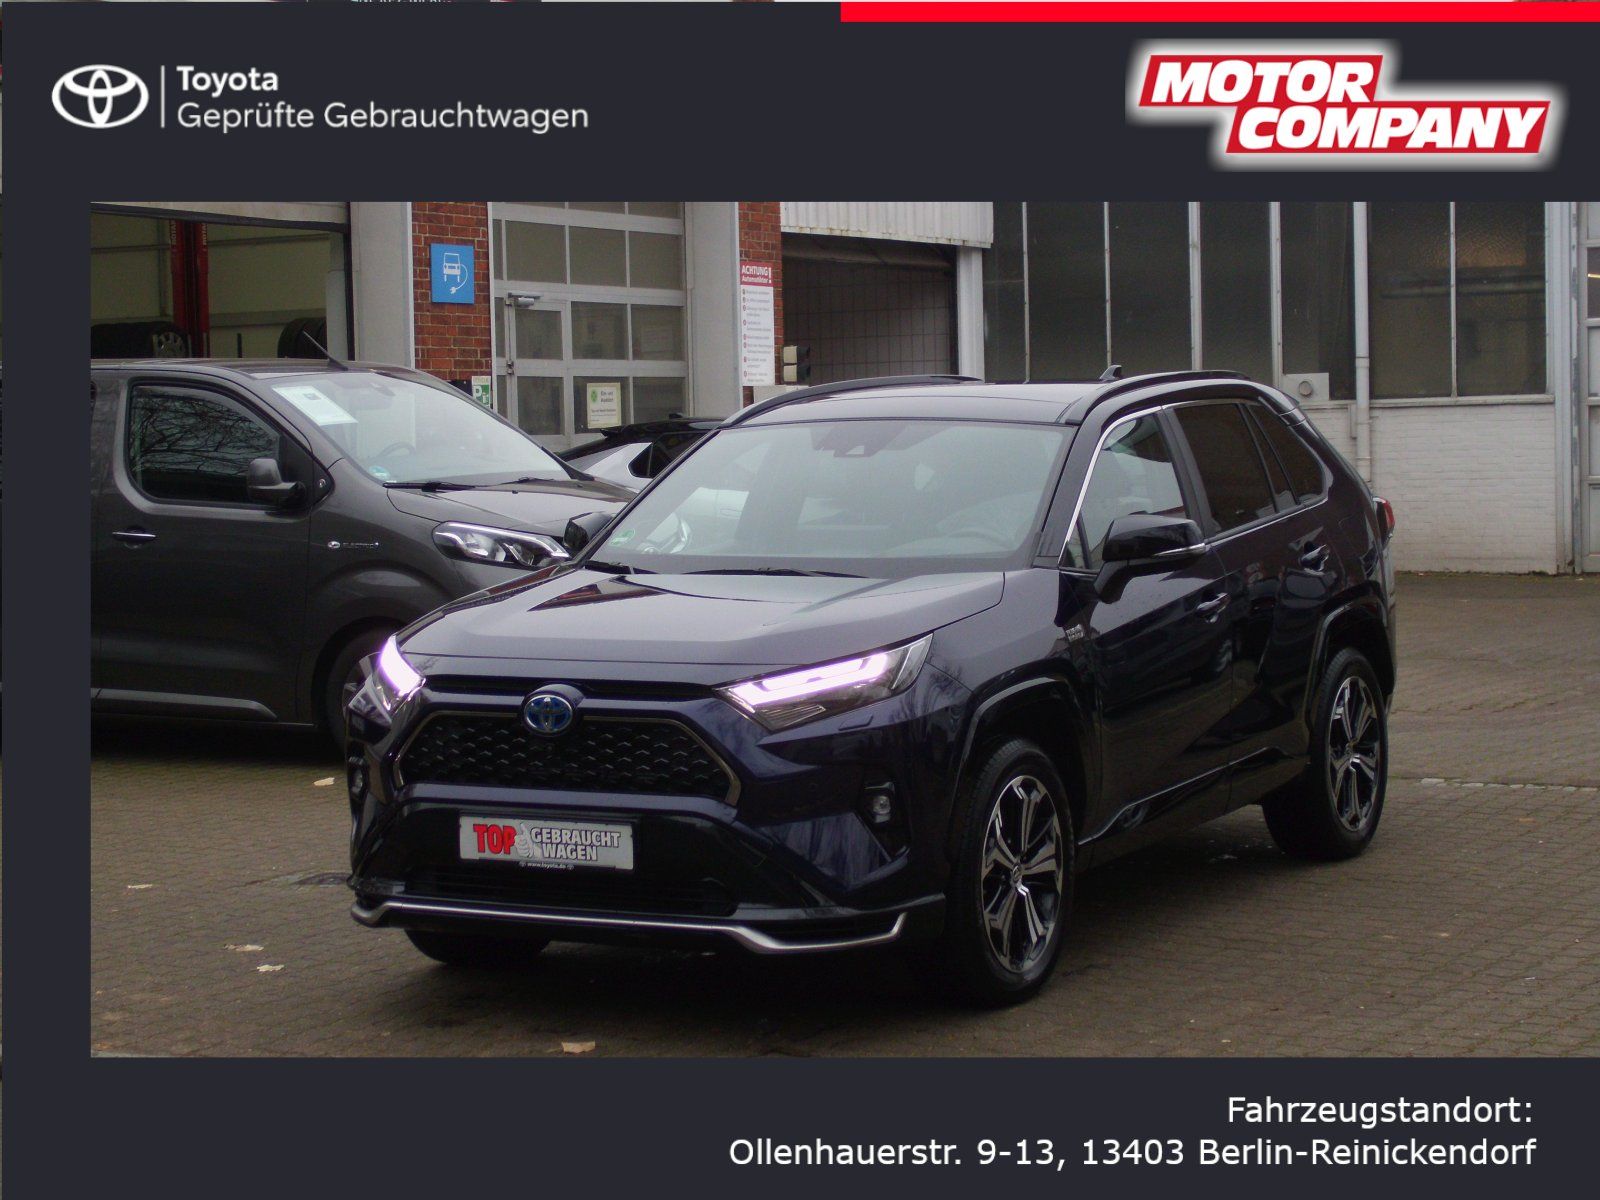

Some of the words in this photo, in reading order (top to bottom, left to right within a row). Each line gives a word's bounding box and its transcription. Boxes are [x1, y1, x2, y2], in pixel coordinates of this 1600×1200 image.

[473, 823, 517, 855] TOP
[530, 827, 622, 848] GEBRAUCHT
[542, 843, 598, 861] WAGEN
